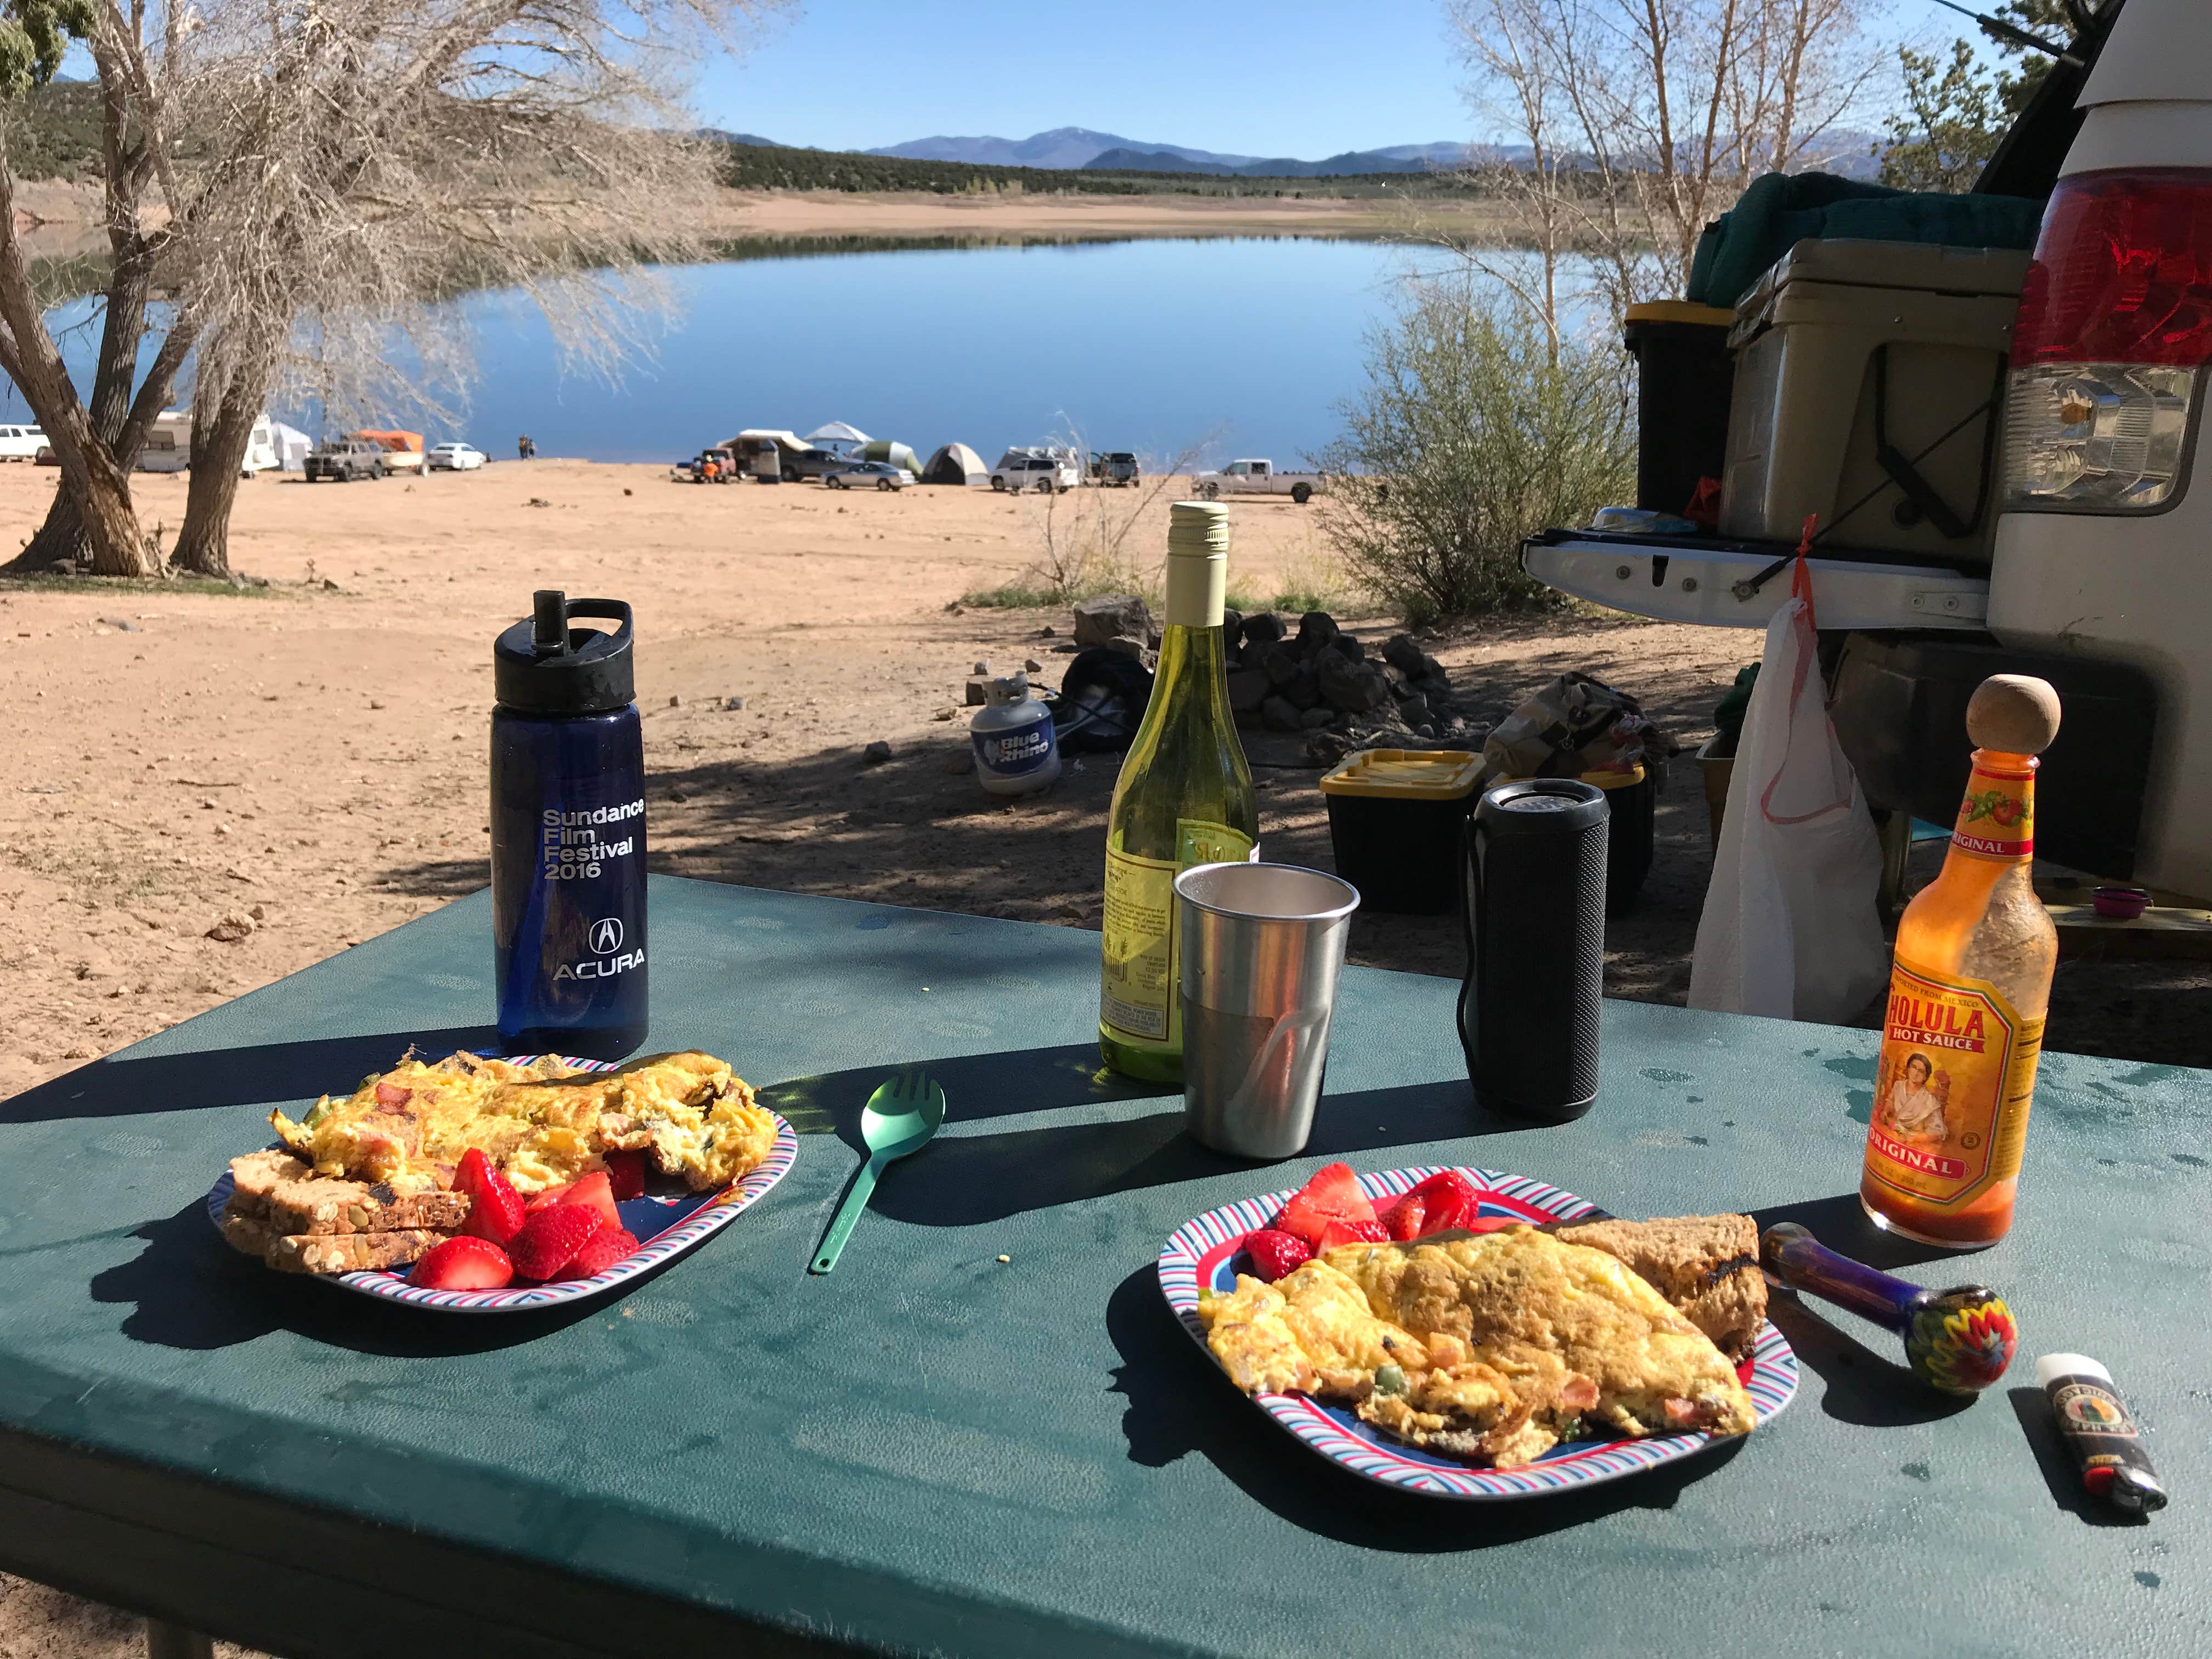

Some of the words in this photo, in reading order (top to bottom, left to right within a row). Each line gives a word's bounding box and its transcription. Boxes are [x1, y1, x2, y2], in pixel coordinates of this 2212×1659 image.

[1002, 732, 1040, 748] Blue
[544, 798, 644, 826] Sundance
[544, 827, 595, 845] Film
[1952, 834, 2005, 853] RIGINAL
[544, 837, 633, 862] Festival
[544, 862, 601, 880] 2016
[553, 949, 645, 981] ACURA
[1921, 989, 1942, 1001] FROM
[1943, 996, 1979, 1008] MEXICO
[1888, 995, 1984, 1039] HOLULA
[1893, 1028, 1920, 1042] HOT
[1922, 1033, 1973, 1051] SAUCE
[1870, 1128, 1952, 1175] ORIGINAL
